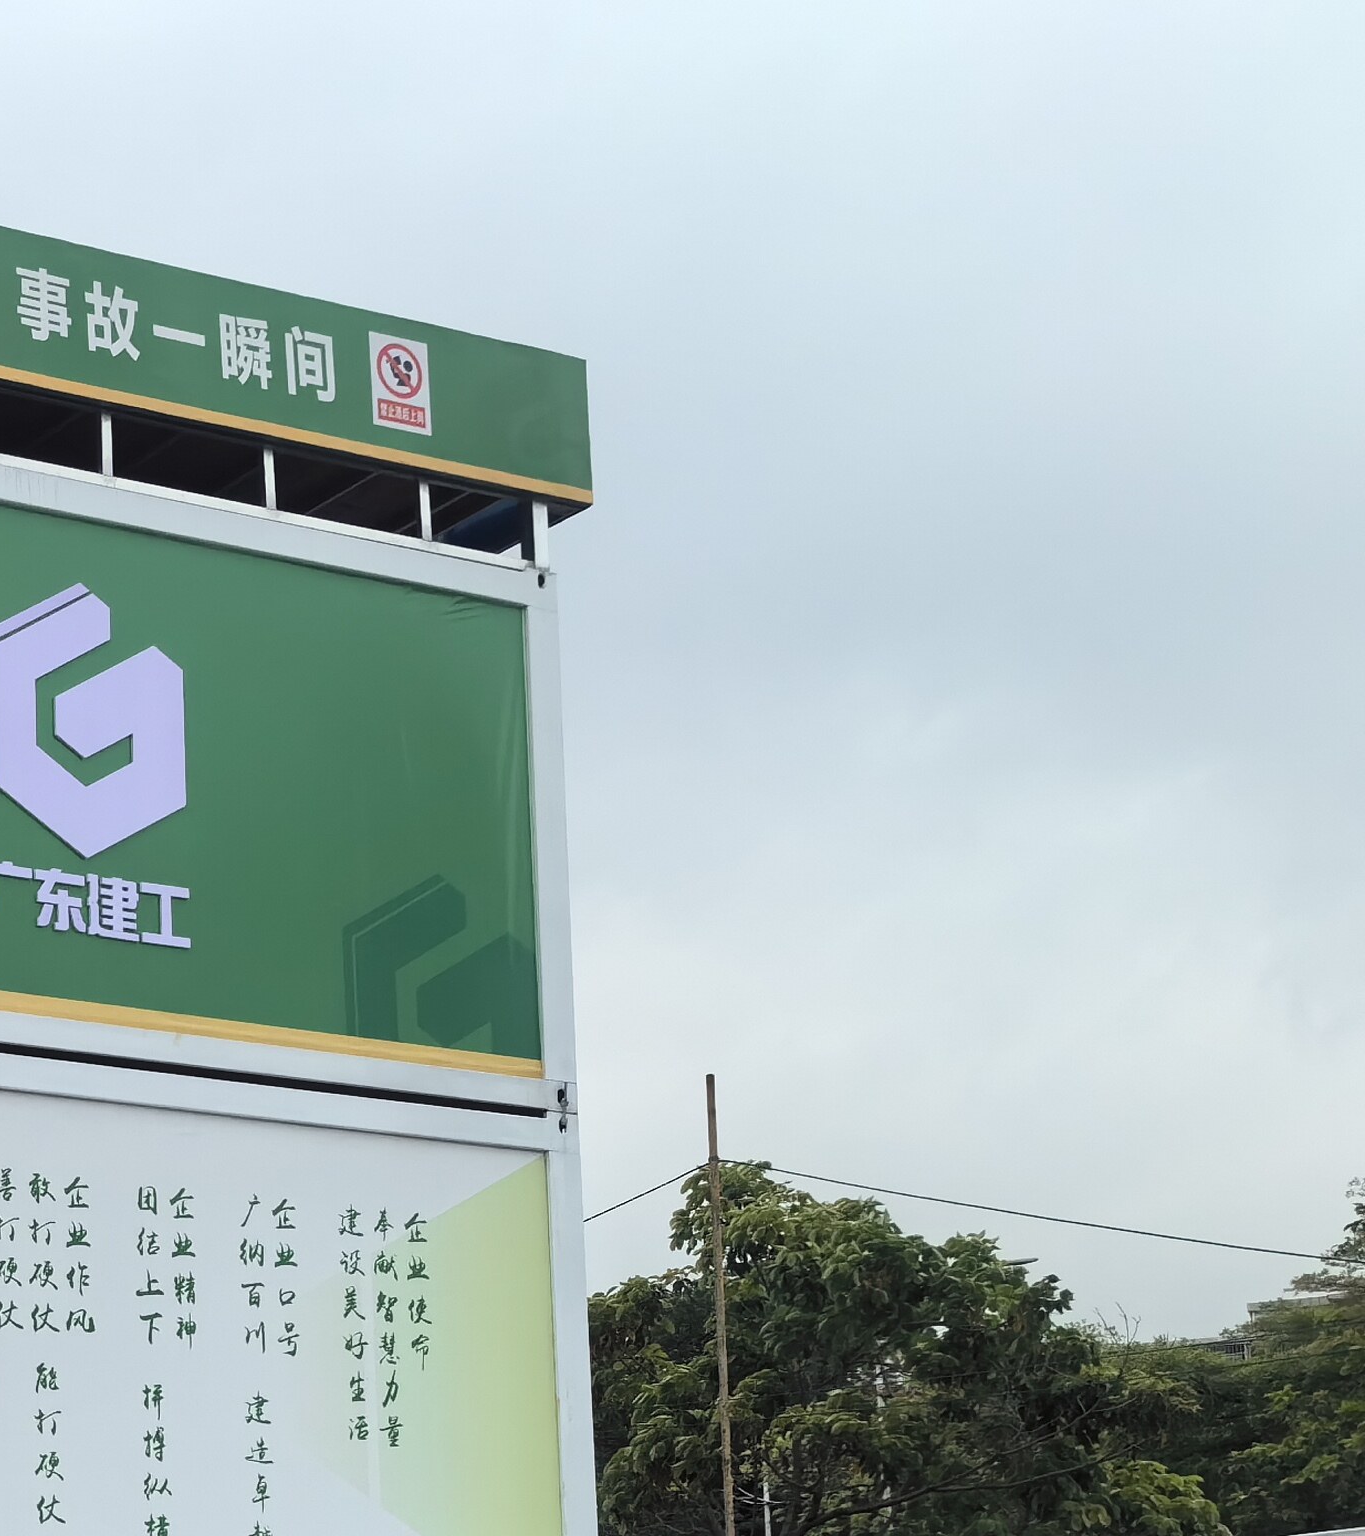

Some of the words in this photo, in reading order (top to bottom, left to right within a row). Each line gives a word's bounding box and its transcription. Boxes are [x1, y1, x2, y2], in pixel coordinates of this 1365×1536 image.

[15, 265, 337, 402] 事故一瞬间
[28, 1172, 61, 1334] 敢打硬仗
[63, 1176, 96, 1335] 企业作风
[135, 1185, 165, 1345] 团结上下
[169, 1187, 198, 1350] 企业精神
[239, 1193, 266, 1355] 广纳百川
[271, 1198, 301, 1357] 企业口号
[338, 1204, 370, 1441] 建设美好生活
[373, 1207, 404, 1448] 奉献智慧力量
[404, 1212, 433, 1371] 企业使命
[34, 1362, 67, 1525] 能打硬仗
